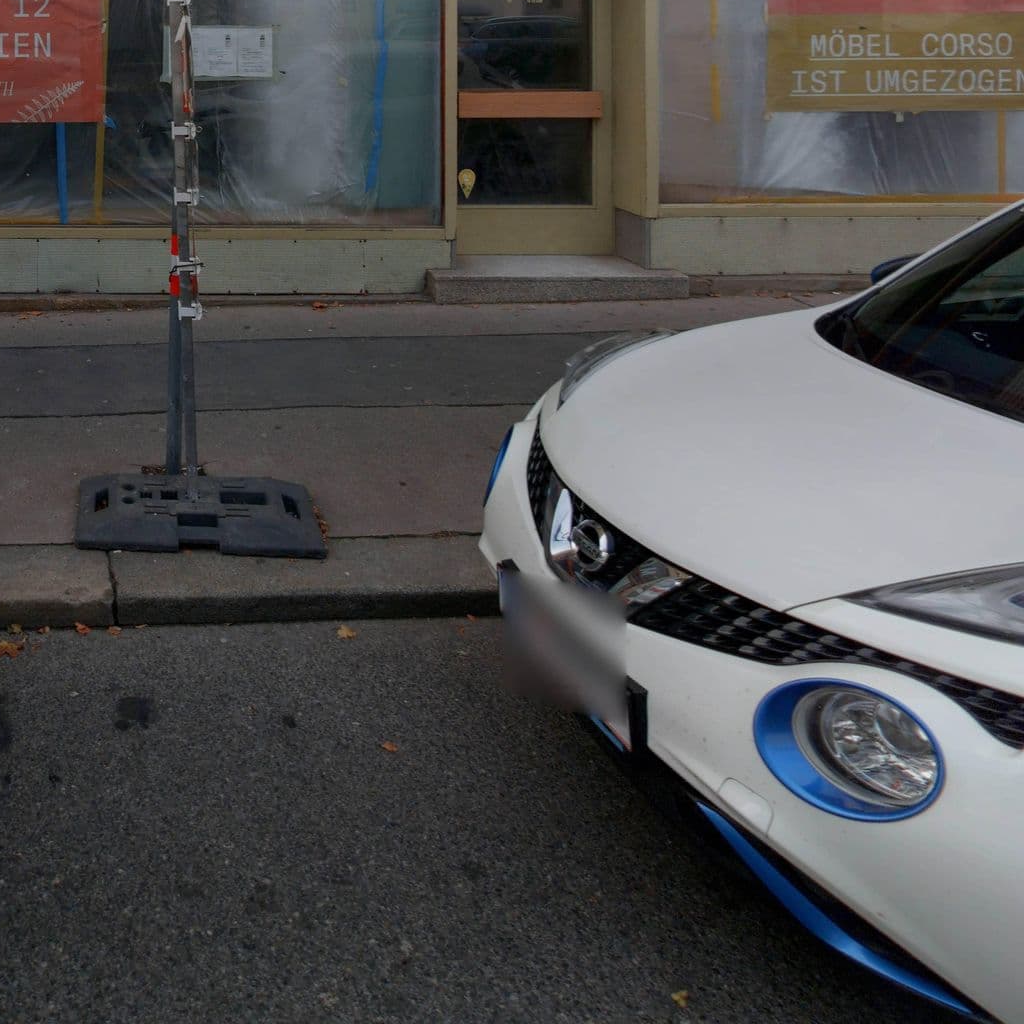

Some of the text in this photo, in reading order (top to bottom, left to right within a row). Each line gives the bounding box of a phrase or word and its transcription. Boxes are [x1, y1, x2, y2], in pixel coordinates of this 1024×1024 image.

[810, 29, 1013, 57] MÖBEL CORSO
[792, 70, 846, 93] IST
